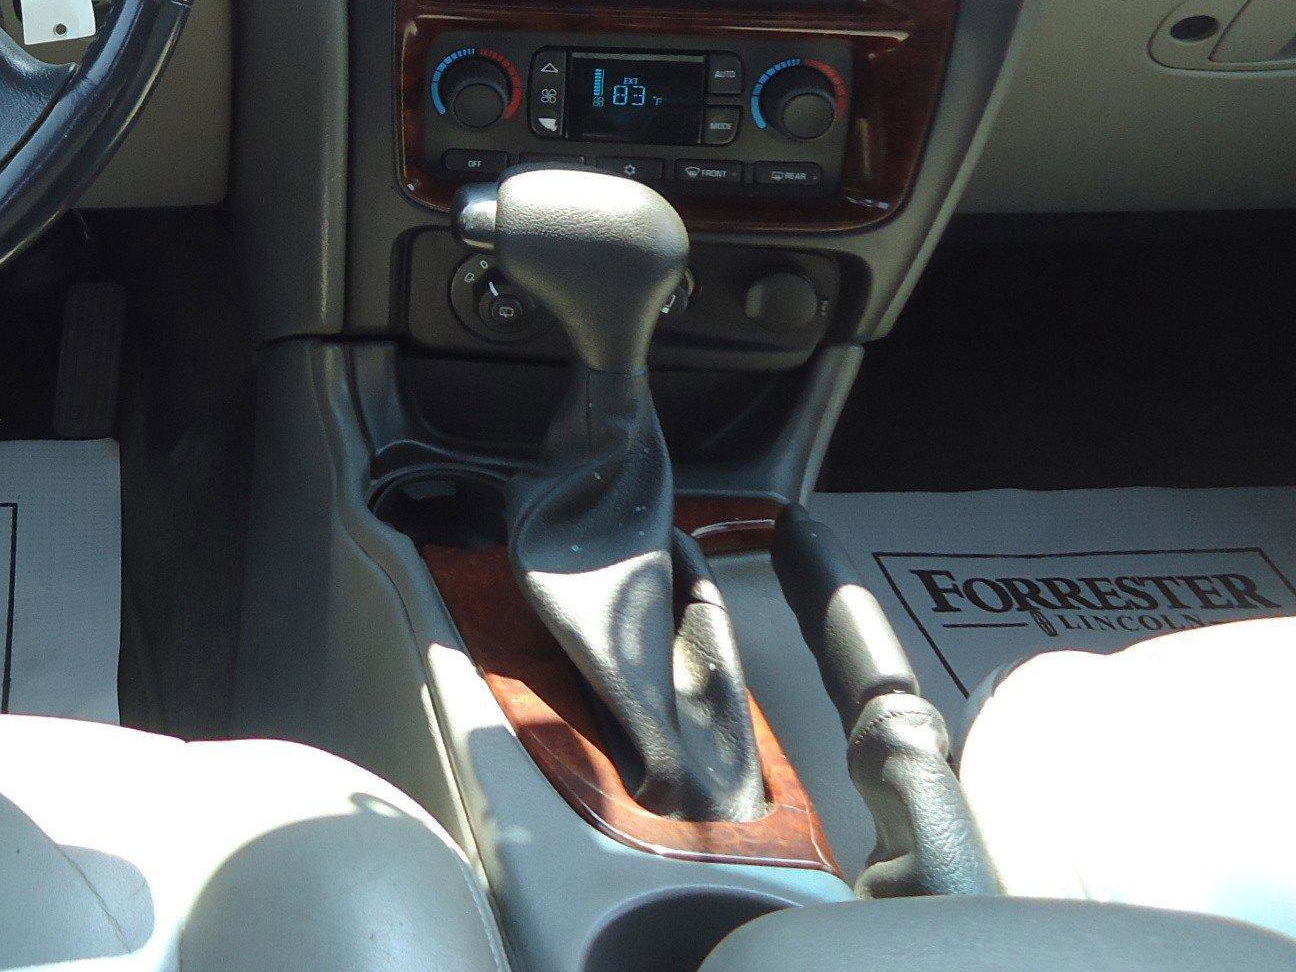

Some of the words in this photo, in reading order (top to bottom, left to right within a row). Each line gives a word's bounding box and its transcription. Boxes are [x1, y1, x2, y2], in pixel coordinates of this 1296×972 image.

[714, 70, 736, 78] AUTO
[612, 85, 646, 106] 83
[710, 122, 733, 130] MODE
[467, 160, 483, 168] OFF
[701, 169, 727, 177] FRONT
[784, 172, 807, 180] REAR
[910, 569, 1282, 614] FORRESTER
[1059, 613, 1206, 632] LINCOLN
